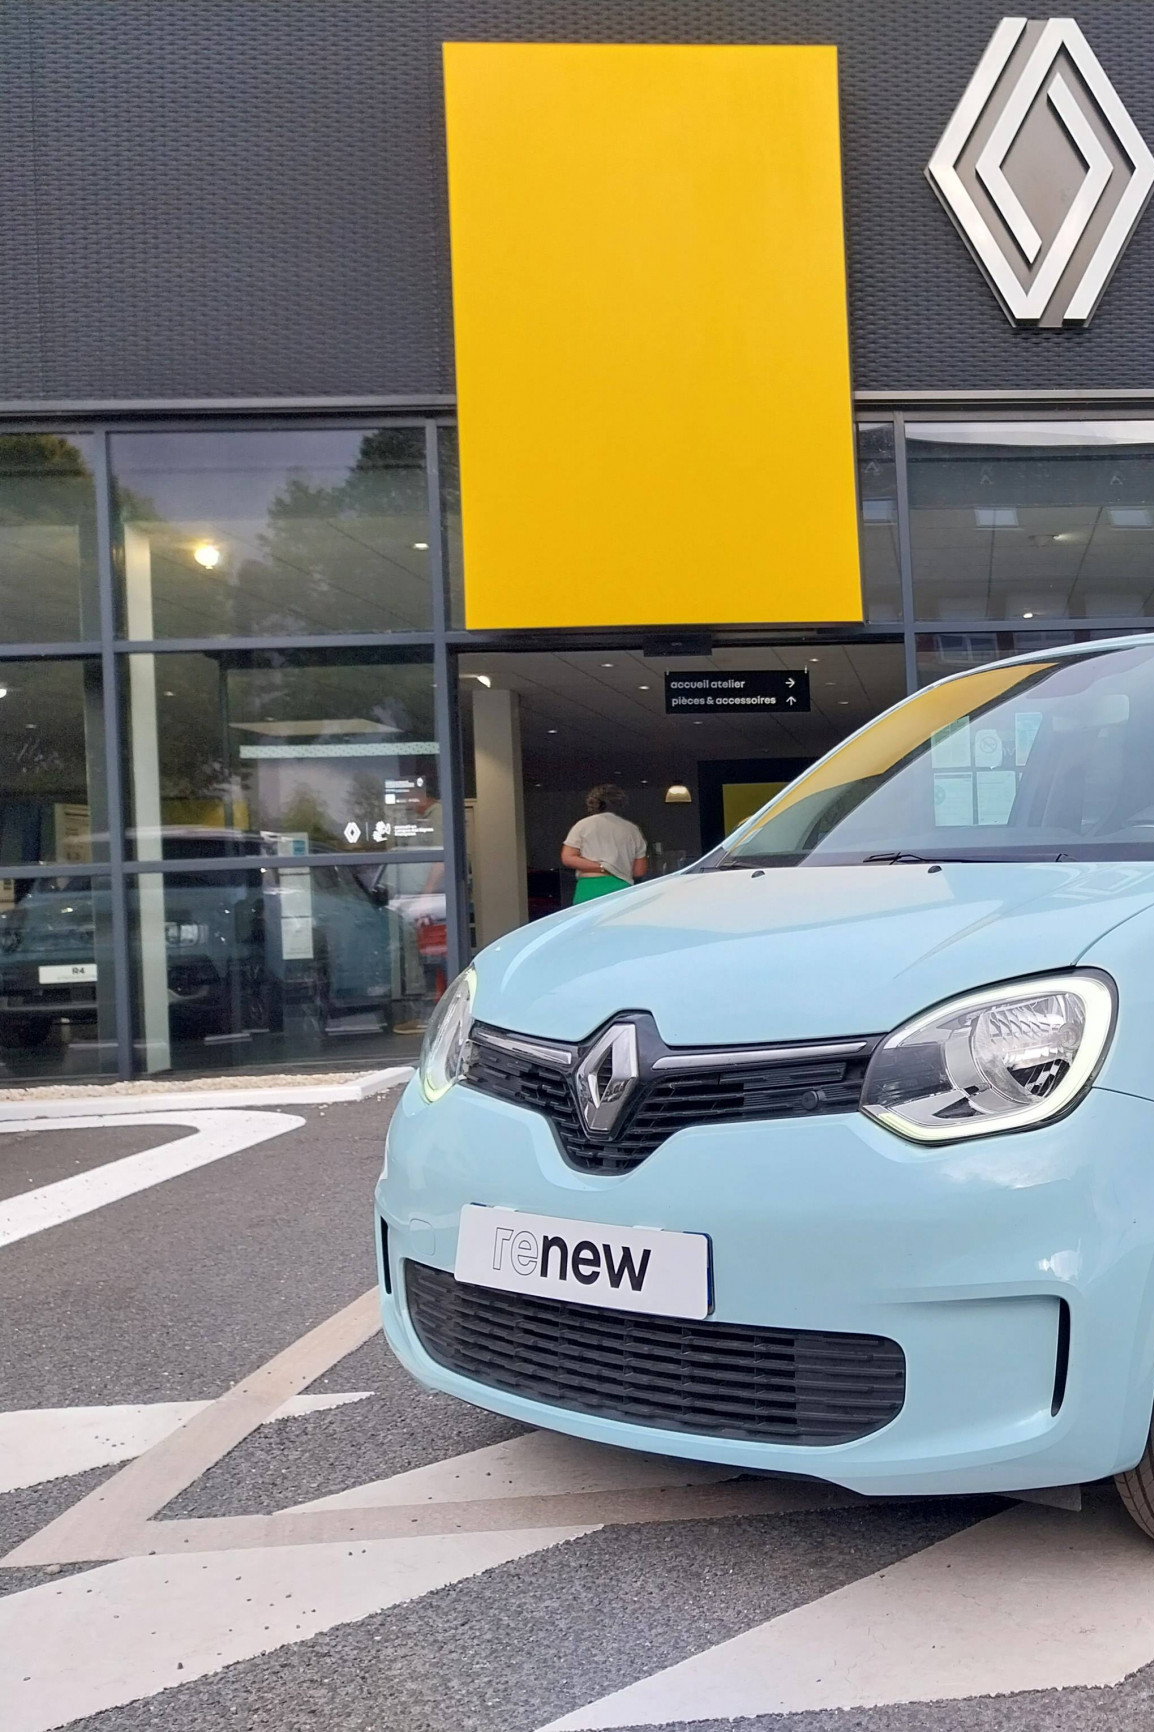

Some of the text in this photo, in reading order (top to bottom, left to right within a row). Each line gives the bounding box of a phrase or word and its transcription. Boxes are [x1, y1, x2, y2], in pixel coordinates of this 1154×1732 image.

[671, 679, 746, 689] accueil atelier
[671, 695, 777, 707] pièces & accessoires
[492, 1227, 652, 1292] renew
